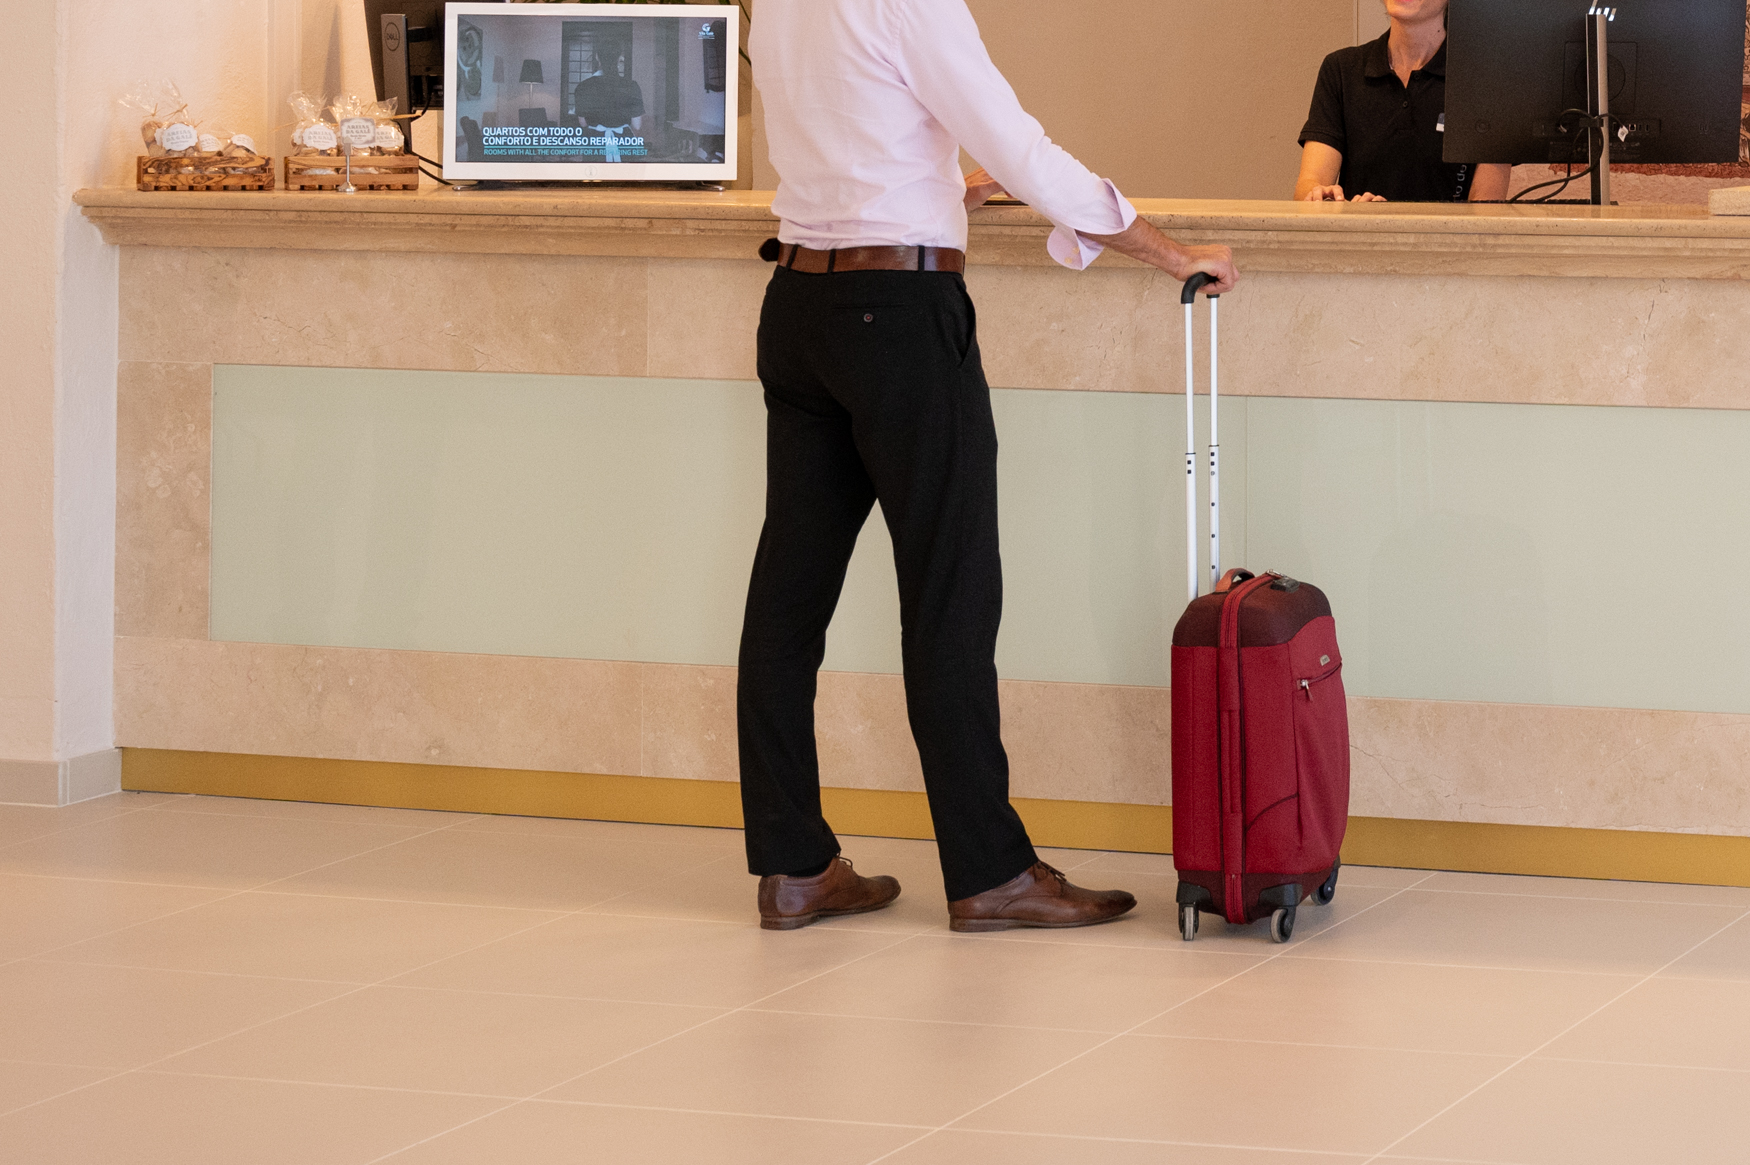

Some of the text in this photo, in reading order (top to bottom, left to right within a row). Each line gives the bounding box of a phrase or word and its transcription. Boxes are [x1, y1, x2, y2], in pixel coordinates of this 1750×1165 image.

[482, 127, 583, 136] QUARTOS COM TODO O
[482, 136, 644, 146] CONFORTO E DESCANSO REPARADOR
